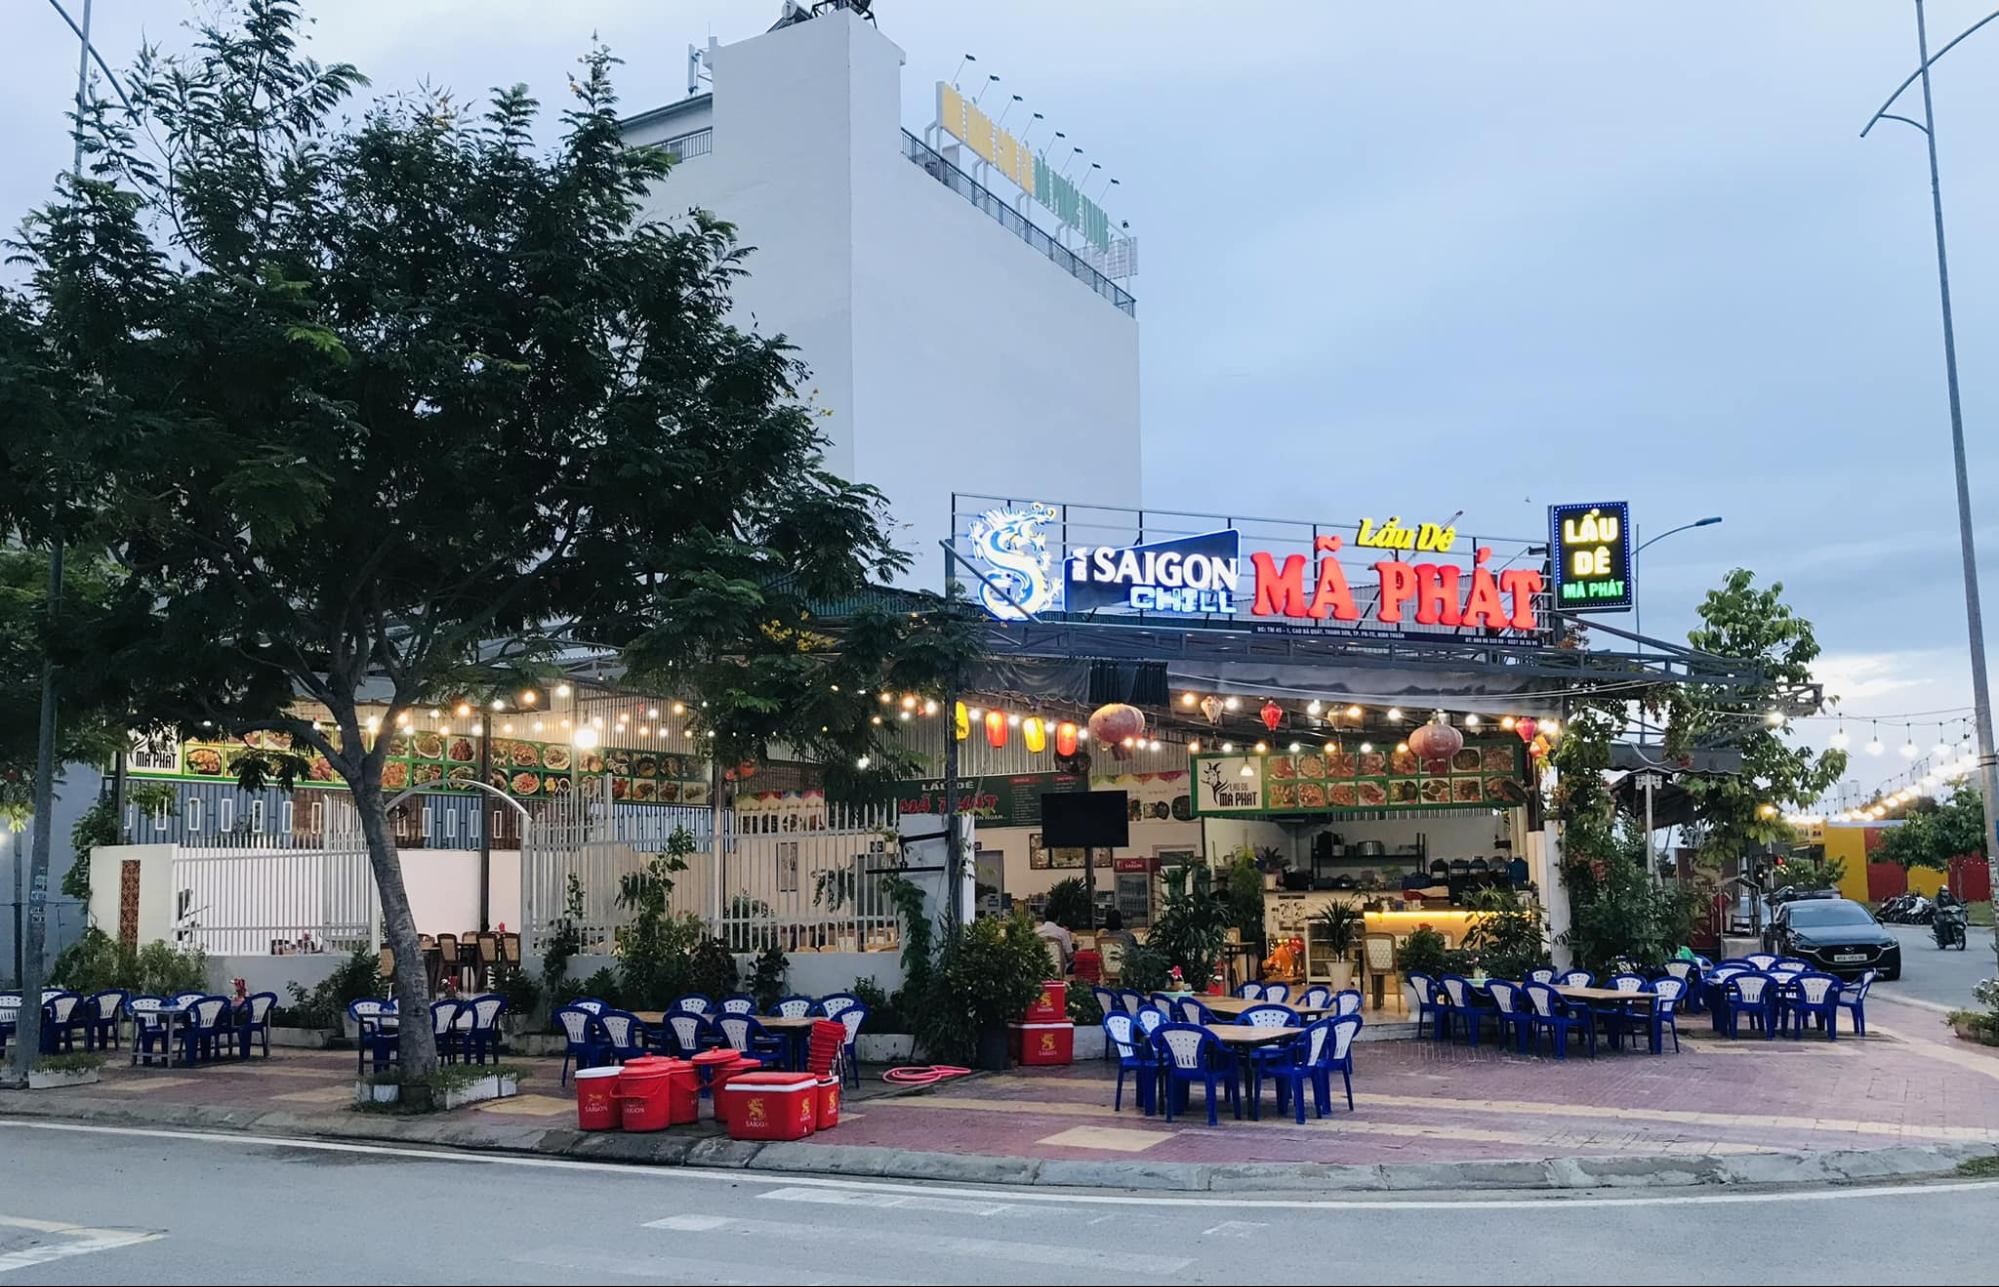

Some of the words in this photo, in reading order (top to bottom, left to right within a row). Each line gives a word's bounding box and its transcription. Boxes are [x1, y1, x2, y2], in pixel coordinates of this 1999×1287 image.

[1416, 523, 1456, 552] Dê
[1093, 546, 1238, 591] SAIGON
[1573, 545, 1611, 575] DÊ
[1250, 535, 1359, 621] MÃ
[1375, 546, 1543, 630] PHÁT
[1563, 580, 1586, 599] MÃ
[1589, 579, 1625, 597] PHÁT
[1131, 586, 1237, 613] CHILL
[1235, 792, 1257, 806] PHAT
